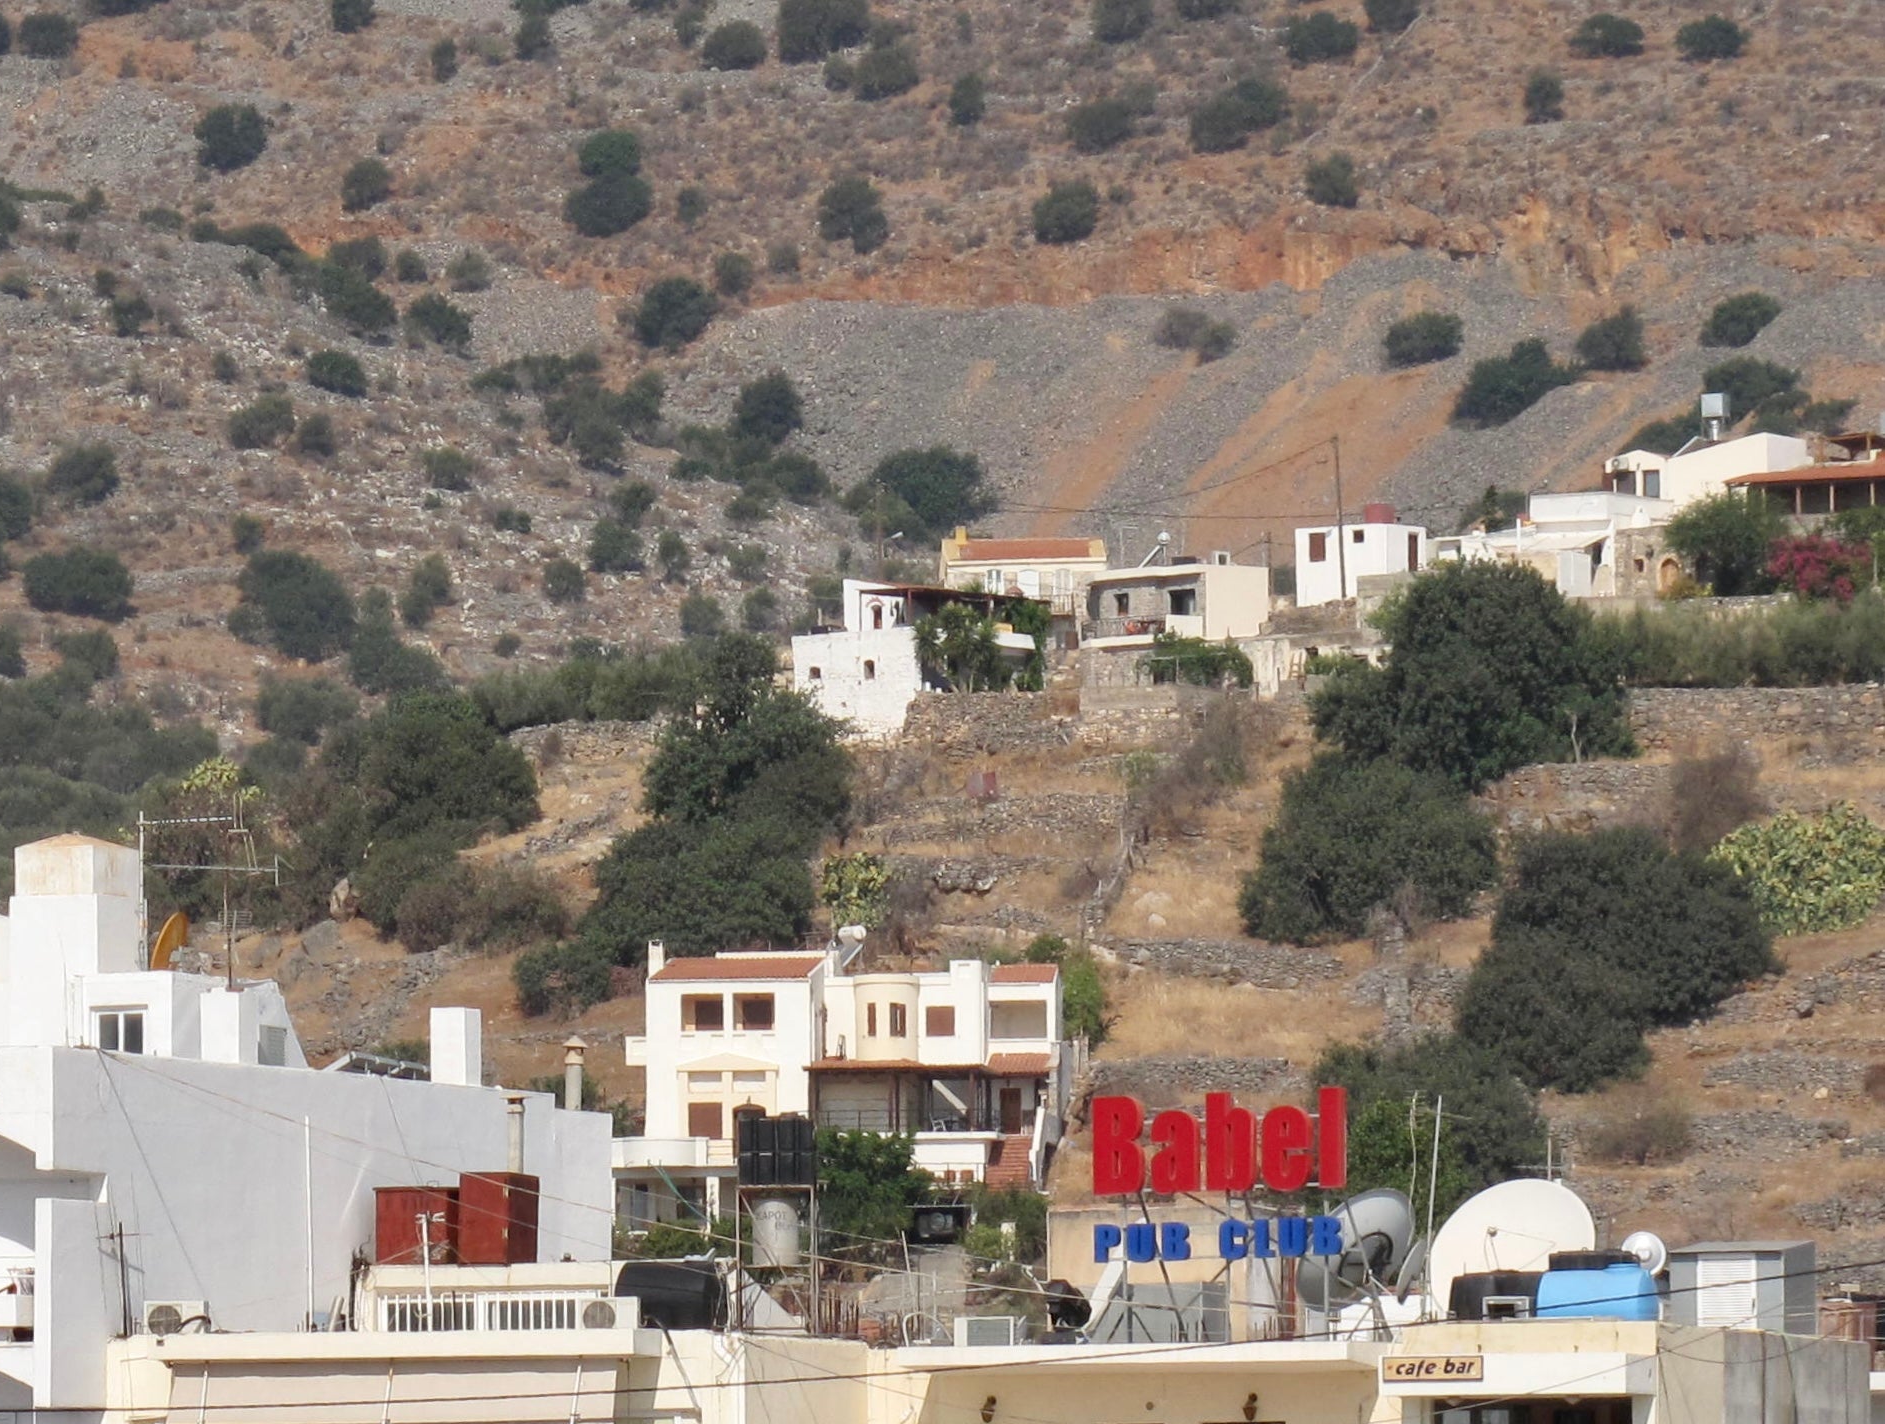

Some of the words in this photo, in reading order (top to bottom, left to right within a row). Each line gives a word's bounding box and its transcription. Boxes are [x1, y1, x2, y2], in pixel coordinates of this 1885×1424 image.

[1092, 1086, 1347, 1195] Babel
[1094, 1222, 1191, 1263] PUB
[1219, 1216, 1343, 1260] CLUB
